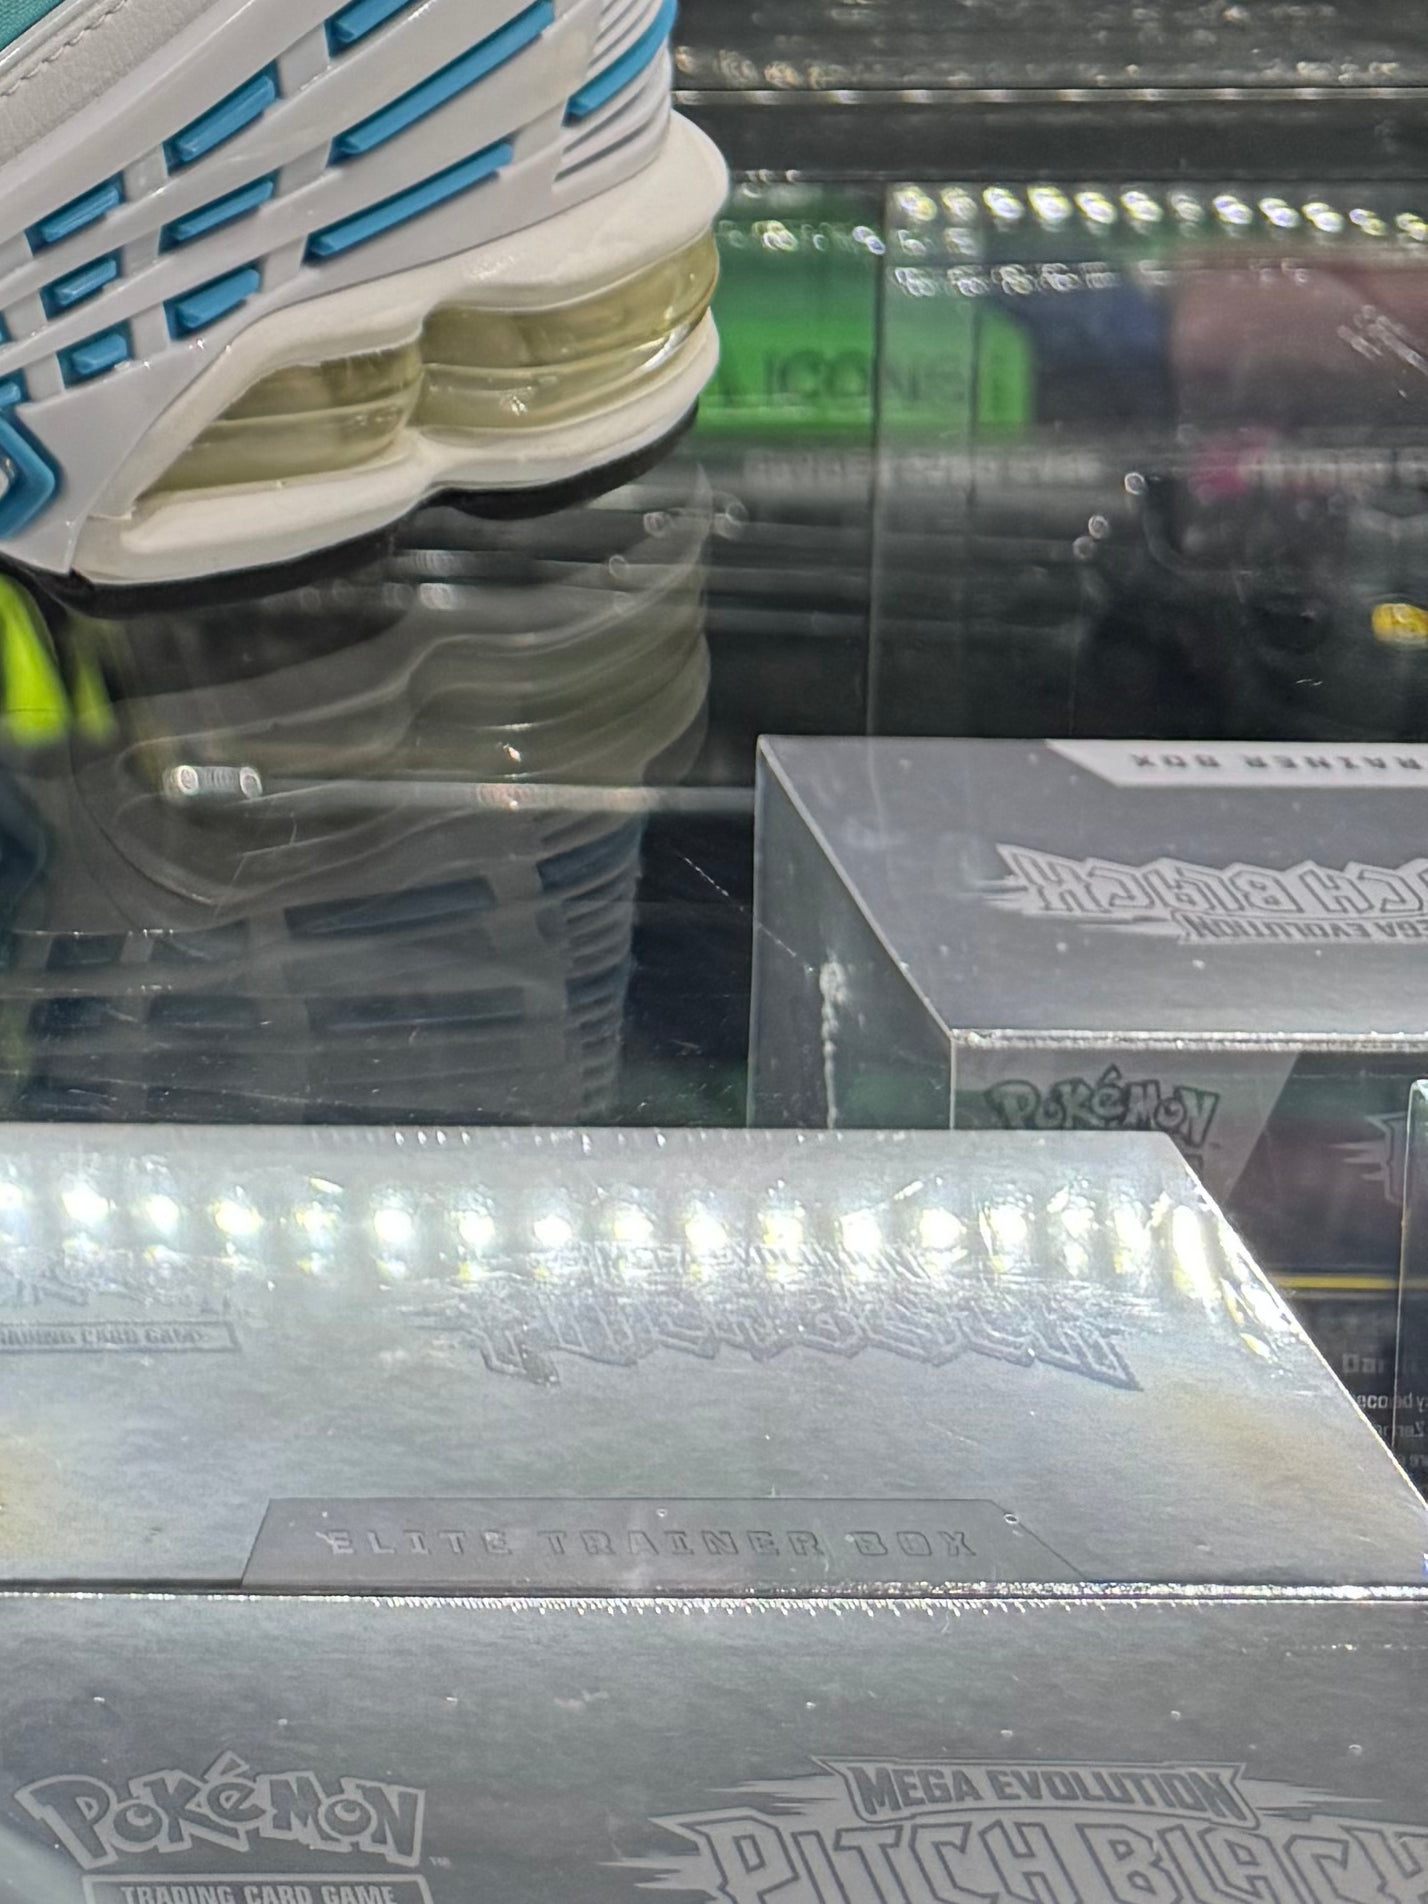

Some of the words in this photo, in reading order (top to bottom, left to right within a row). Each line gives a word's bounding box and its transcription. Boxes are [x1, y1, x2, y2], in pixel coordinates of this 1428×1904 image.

[325, 1529, 511, 1555] ELITE
[539, 1530, 824, 1557] TRAINER
[848, 1530, 978, 1557] BOX
[847, 1766, 985, 1817] MEGA
[986, 1768, 1245, 1822] EVOLUTION
